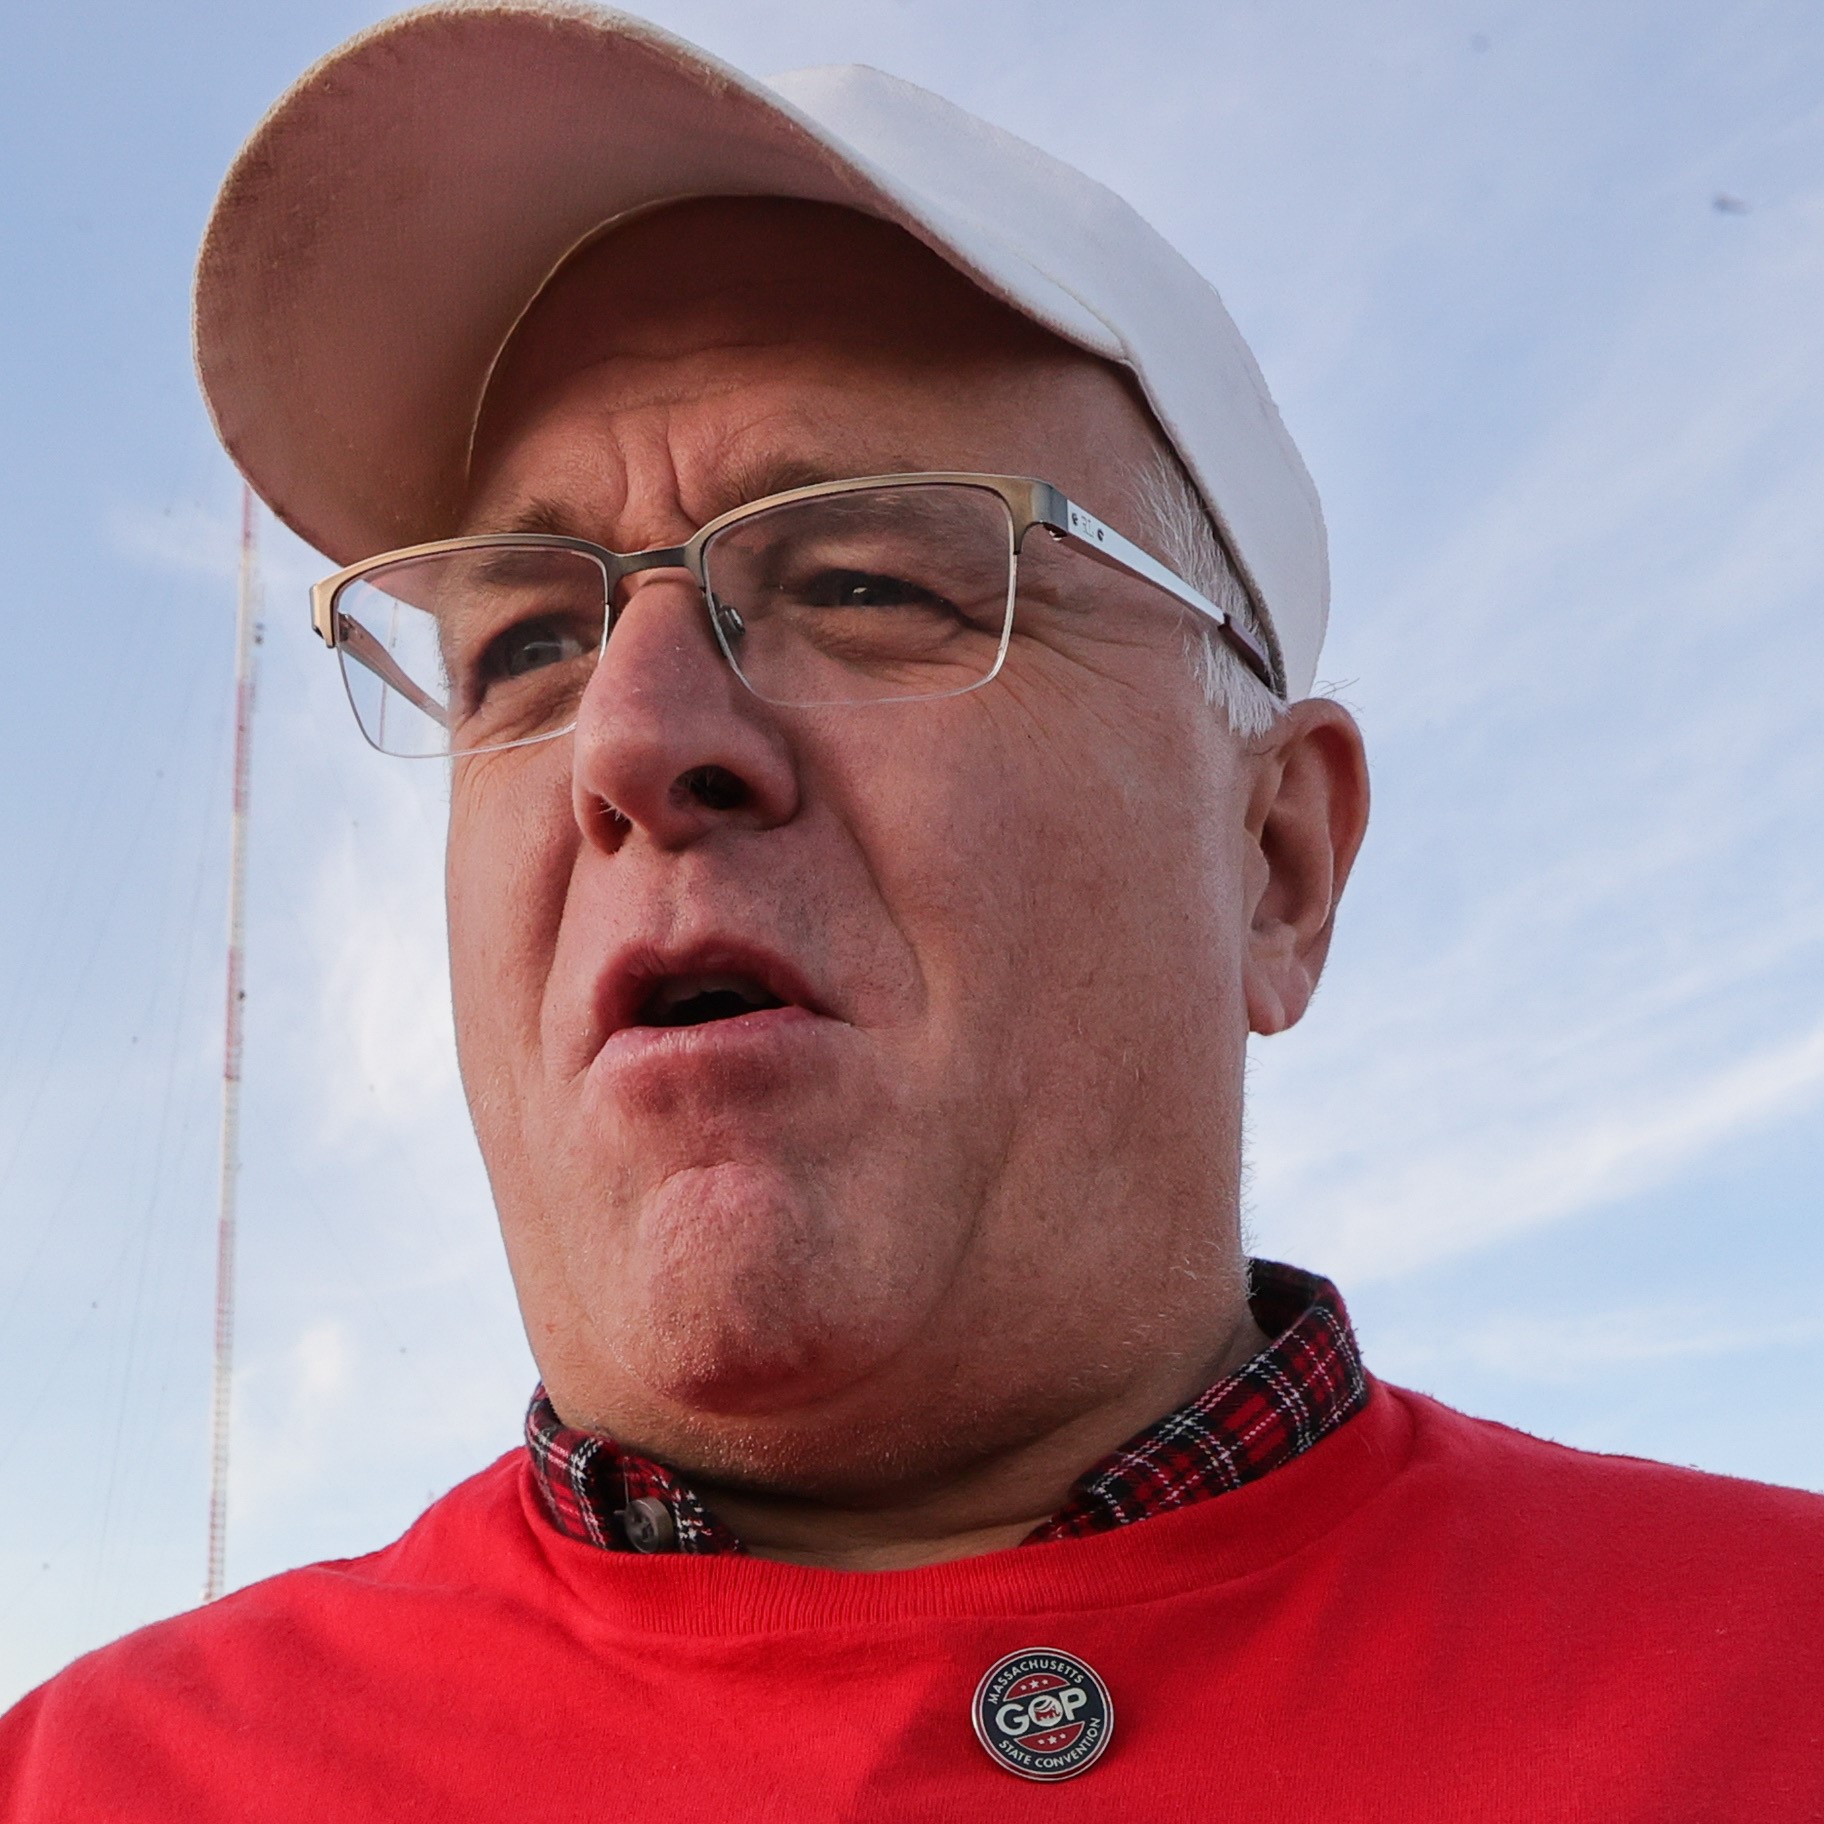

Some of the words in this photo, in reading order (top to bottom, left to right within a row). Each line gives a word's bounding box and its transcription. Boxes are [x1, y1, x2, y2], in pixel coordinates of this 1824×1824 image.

[988, 1659, 1085, 1705] MASSACHUSETTS
[996, 1687, 1088, 1736] GOP
[999, 1740, 1032, 1765] STATE
[1035, 1717, 1102, 1769] CONVENTION
